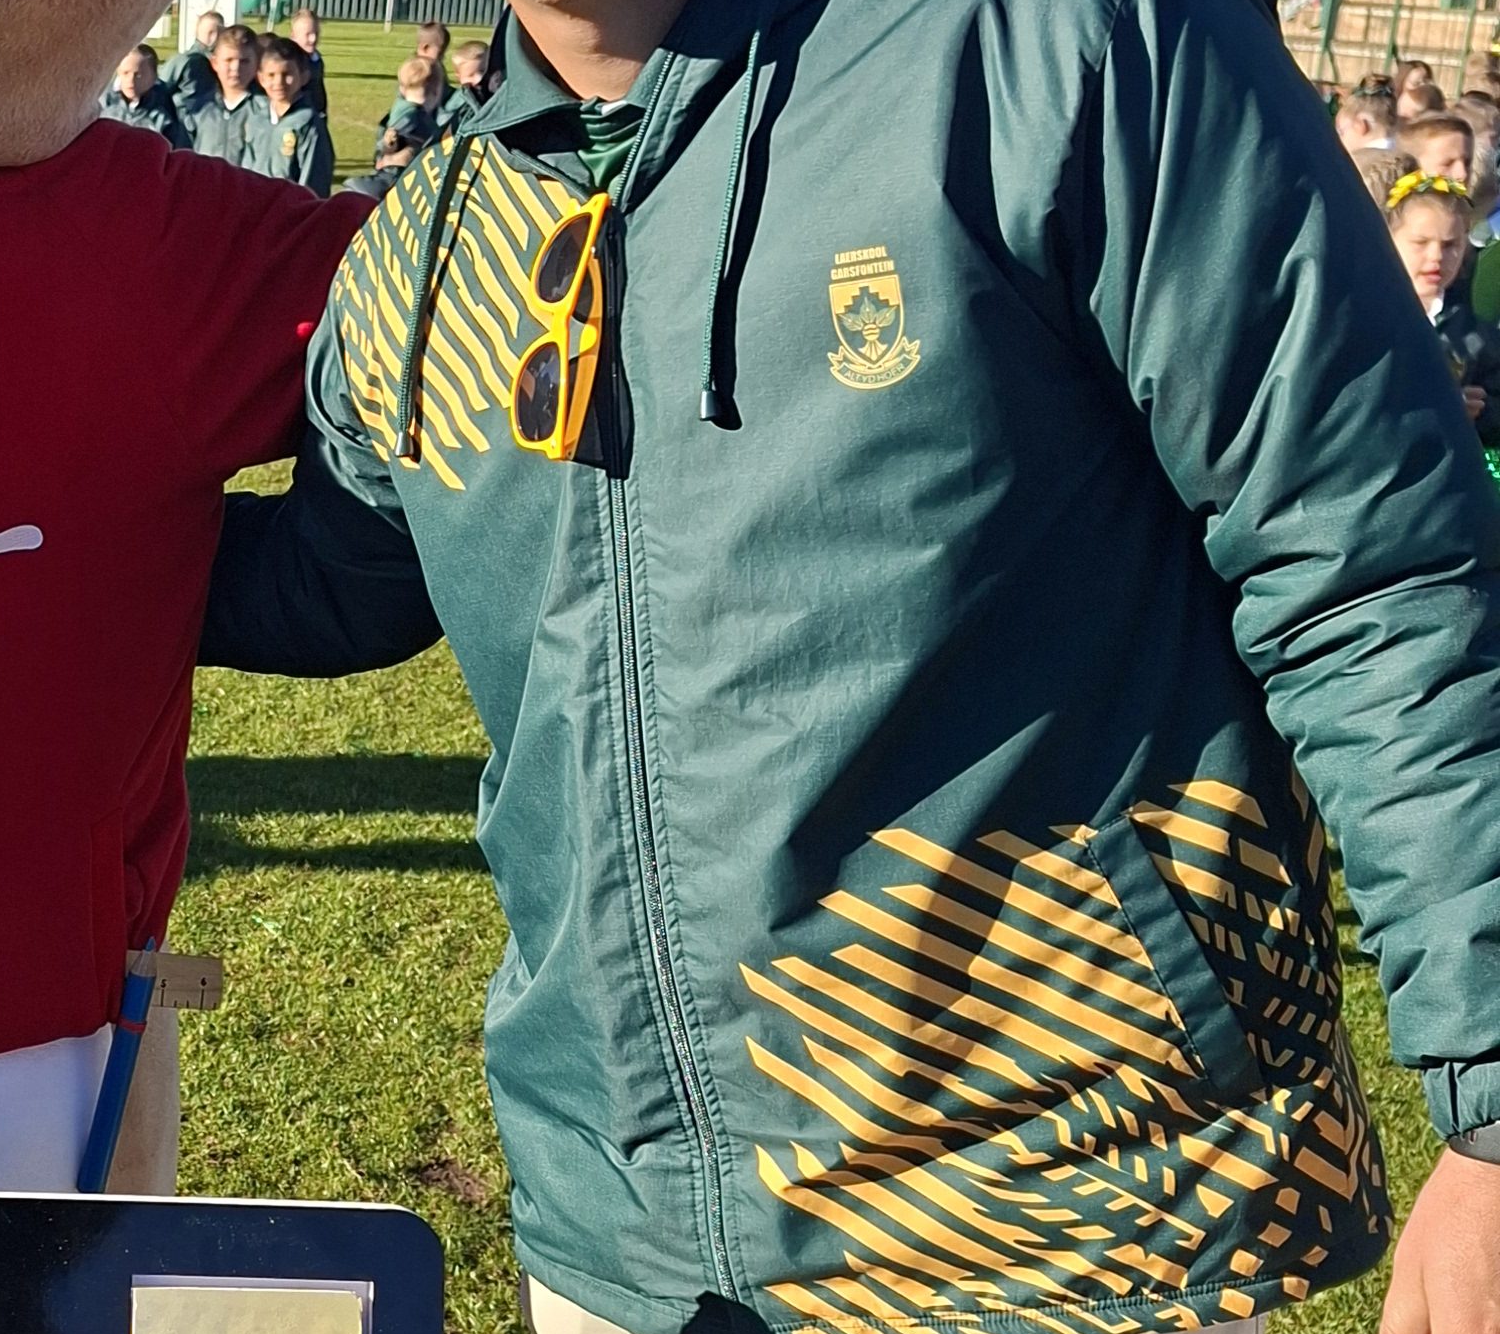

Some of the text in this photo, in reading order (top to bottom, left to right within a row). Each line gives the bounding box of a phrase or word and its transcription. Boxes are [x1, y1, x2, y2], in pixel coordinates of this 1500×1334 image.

[835, 246, 887, 264] LAERSKOOL
[831, 260, 894, 280] GARSFONTEIN
[160, 978, 167, 988] 5
[200, 976, 207, 987] 6
